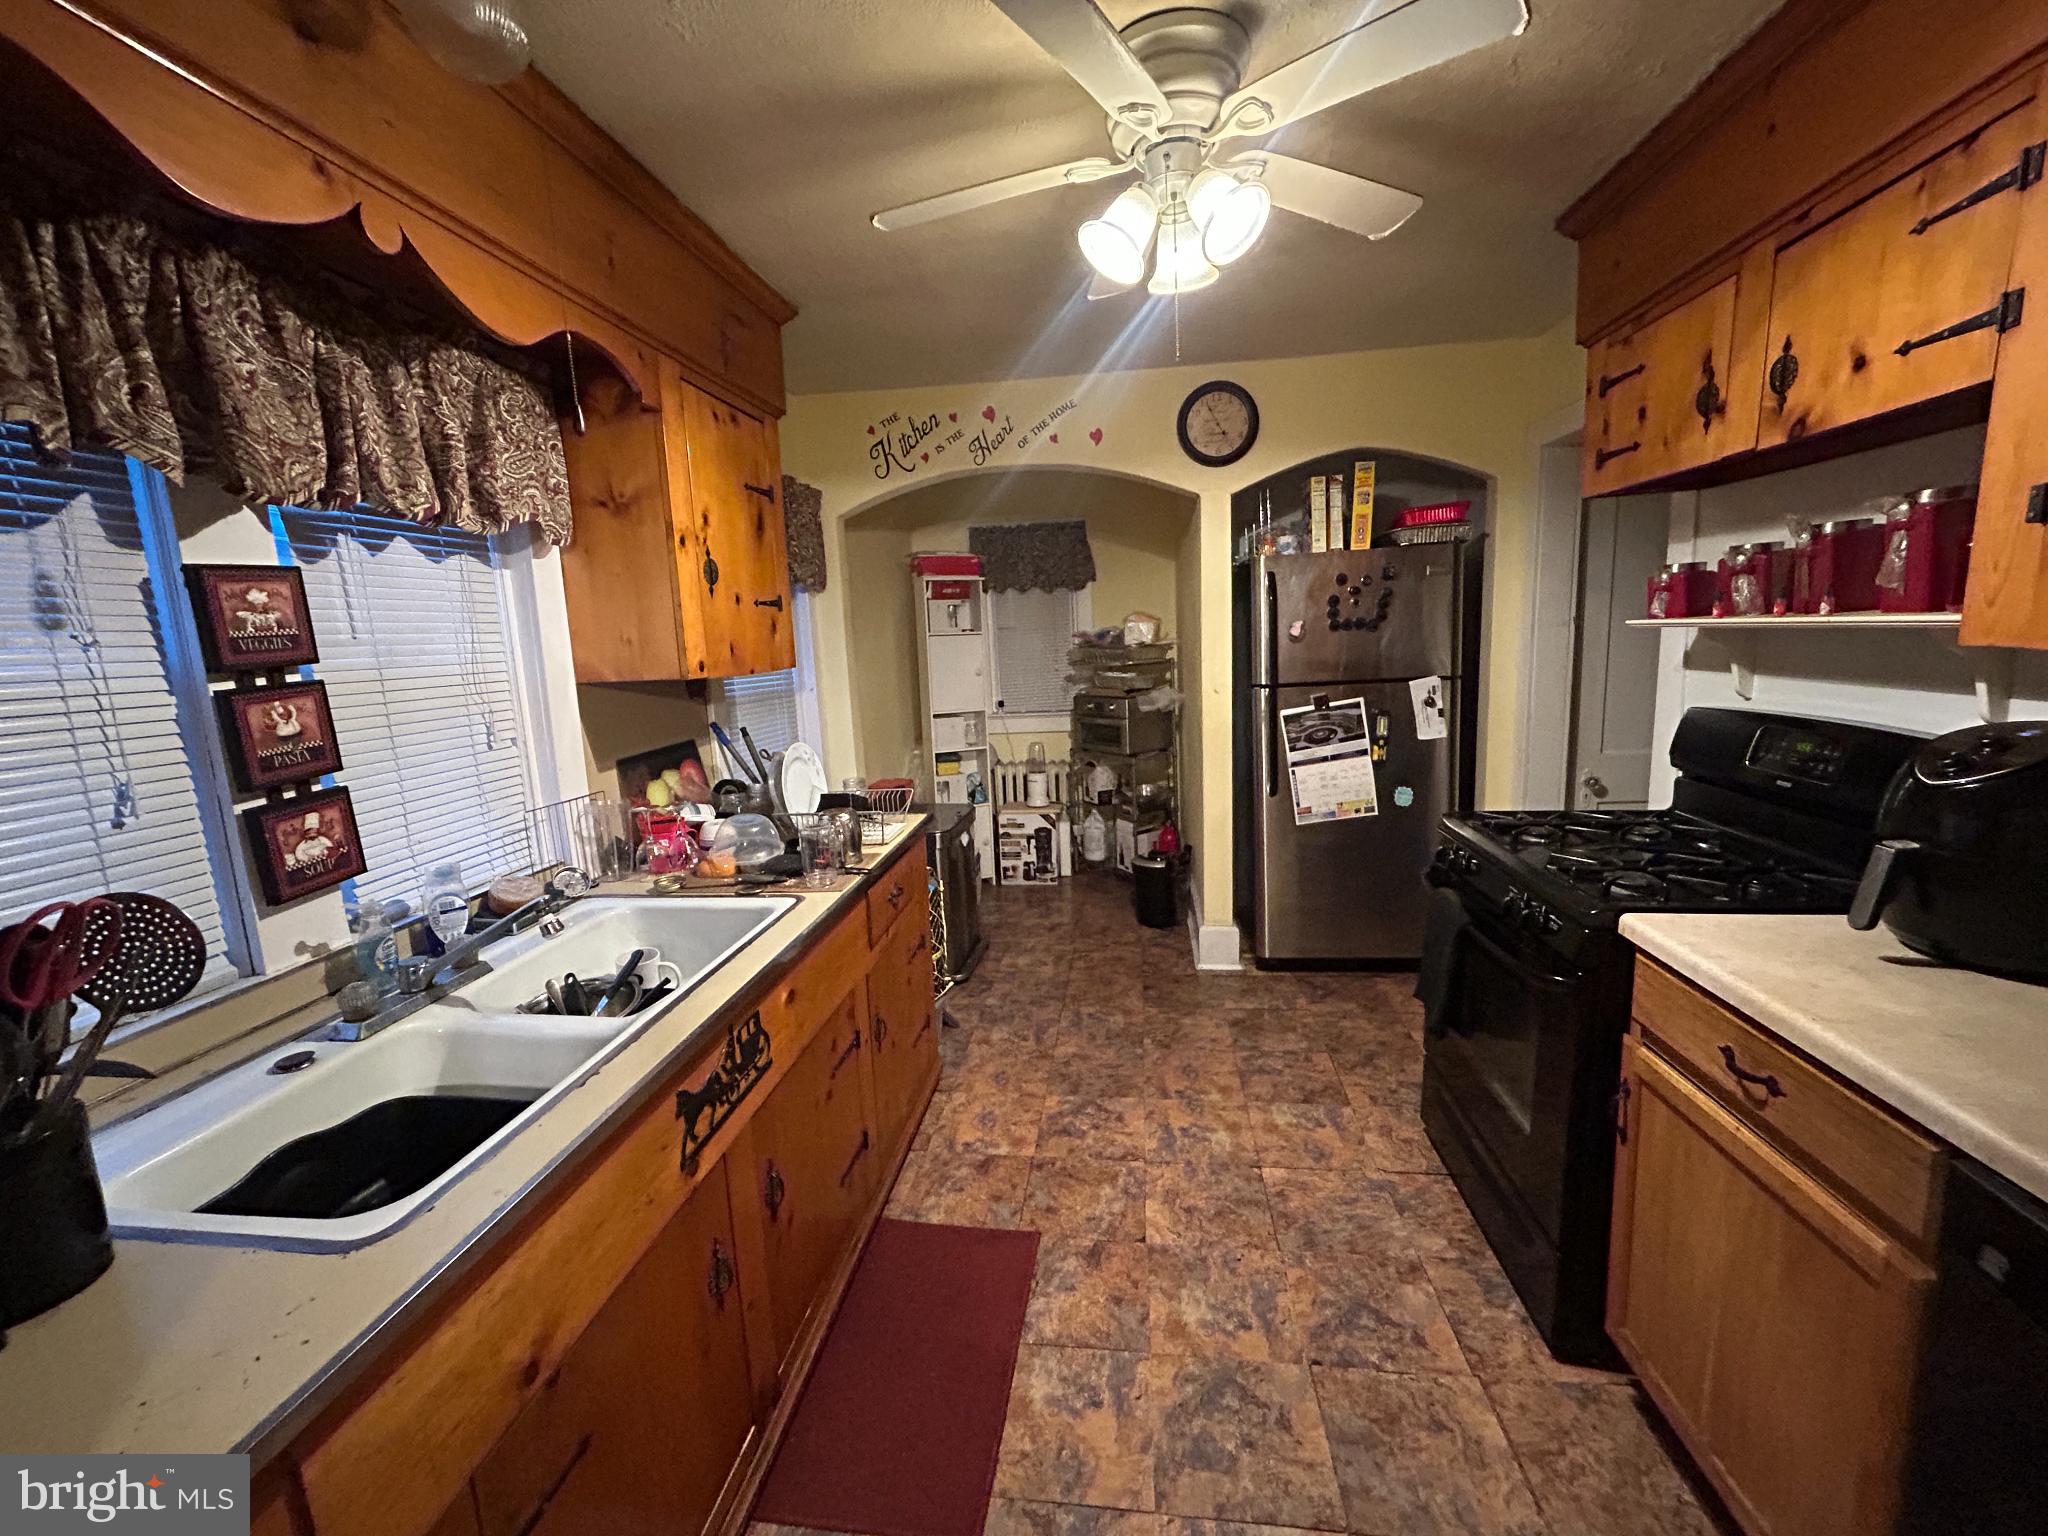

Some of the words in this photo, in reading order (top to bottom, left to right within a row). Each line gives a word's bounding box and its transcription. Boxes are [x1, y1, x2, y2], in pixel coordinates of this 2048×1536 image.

[880, 412, 901, 428] THE
[1018, 435, 1029, 449] OF
[1031, 419, 1050, 436] THE
[1048, 399, 1077, 421] HOME
[870, 414, 940, 479] Kitchen
[934, 443, 945, 454] IS
[945, 429, 964, 445] THE
[969, 414, 1014, 466] Heart
[238, 636, 293, 651] VEGGIES
[273, 750, 311, 767] PASTA
[303, 858, 336, 879] SOUP
